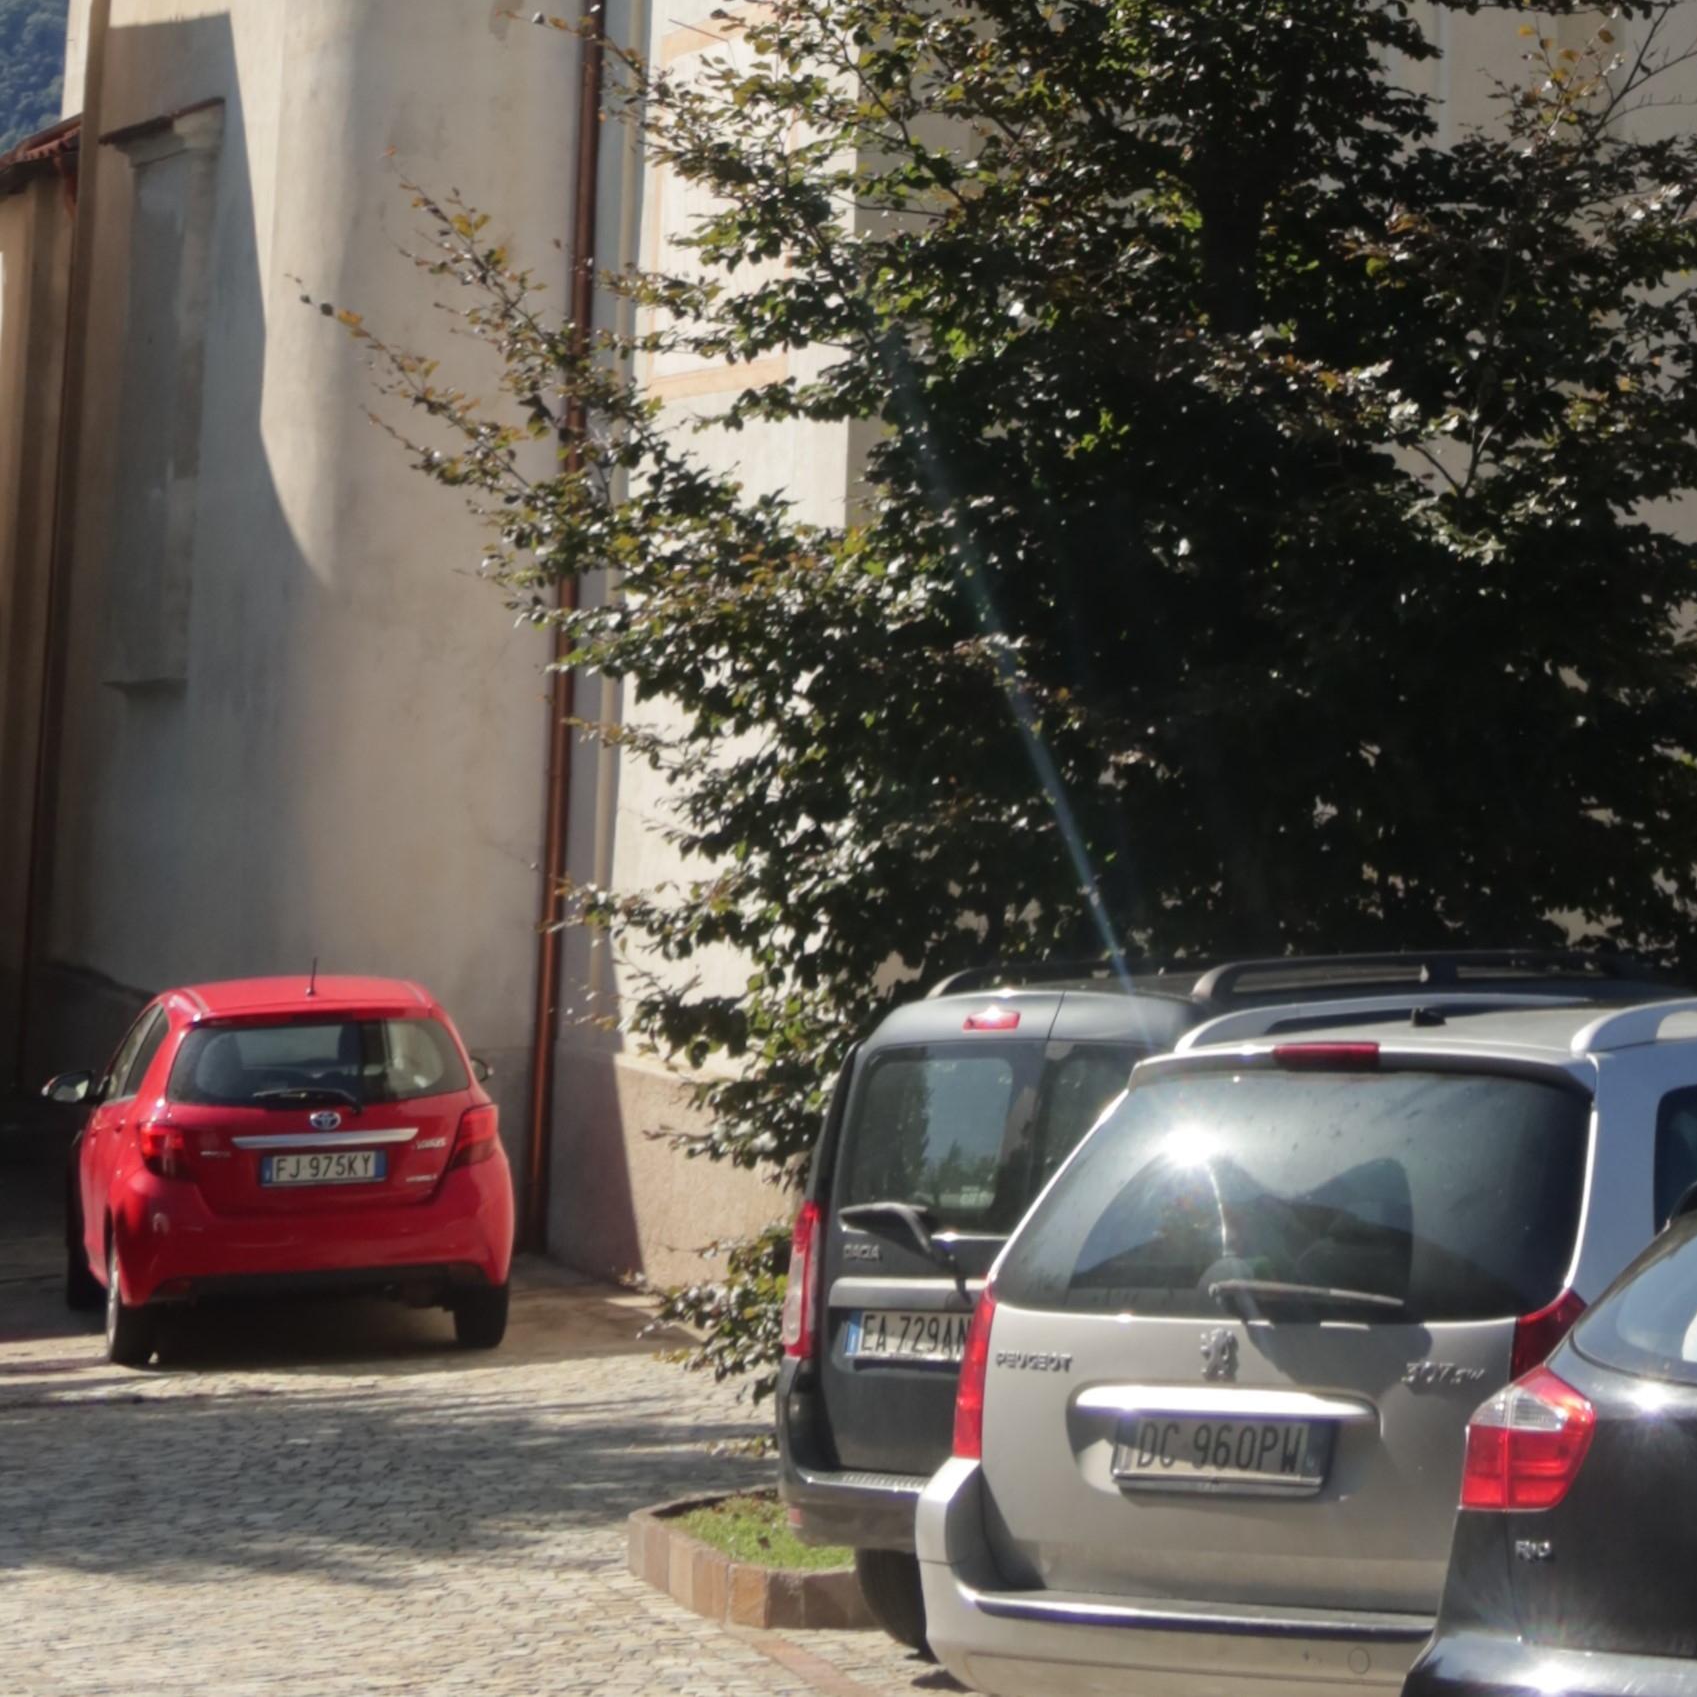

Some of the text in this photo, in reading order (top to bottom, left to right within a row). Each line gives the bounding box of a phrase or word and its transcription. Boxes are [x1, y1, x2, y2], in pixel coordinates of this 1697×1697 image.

[275, 1153, 373, 1180] FJ 975KY
[862, 1314, 972, 1354] EA 729AN
[995, 1350, 1073, 1373] PEUGEOT
[1137, 1421, 1303, 1474] DC 960PW
